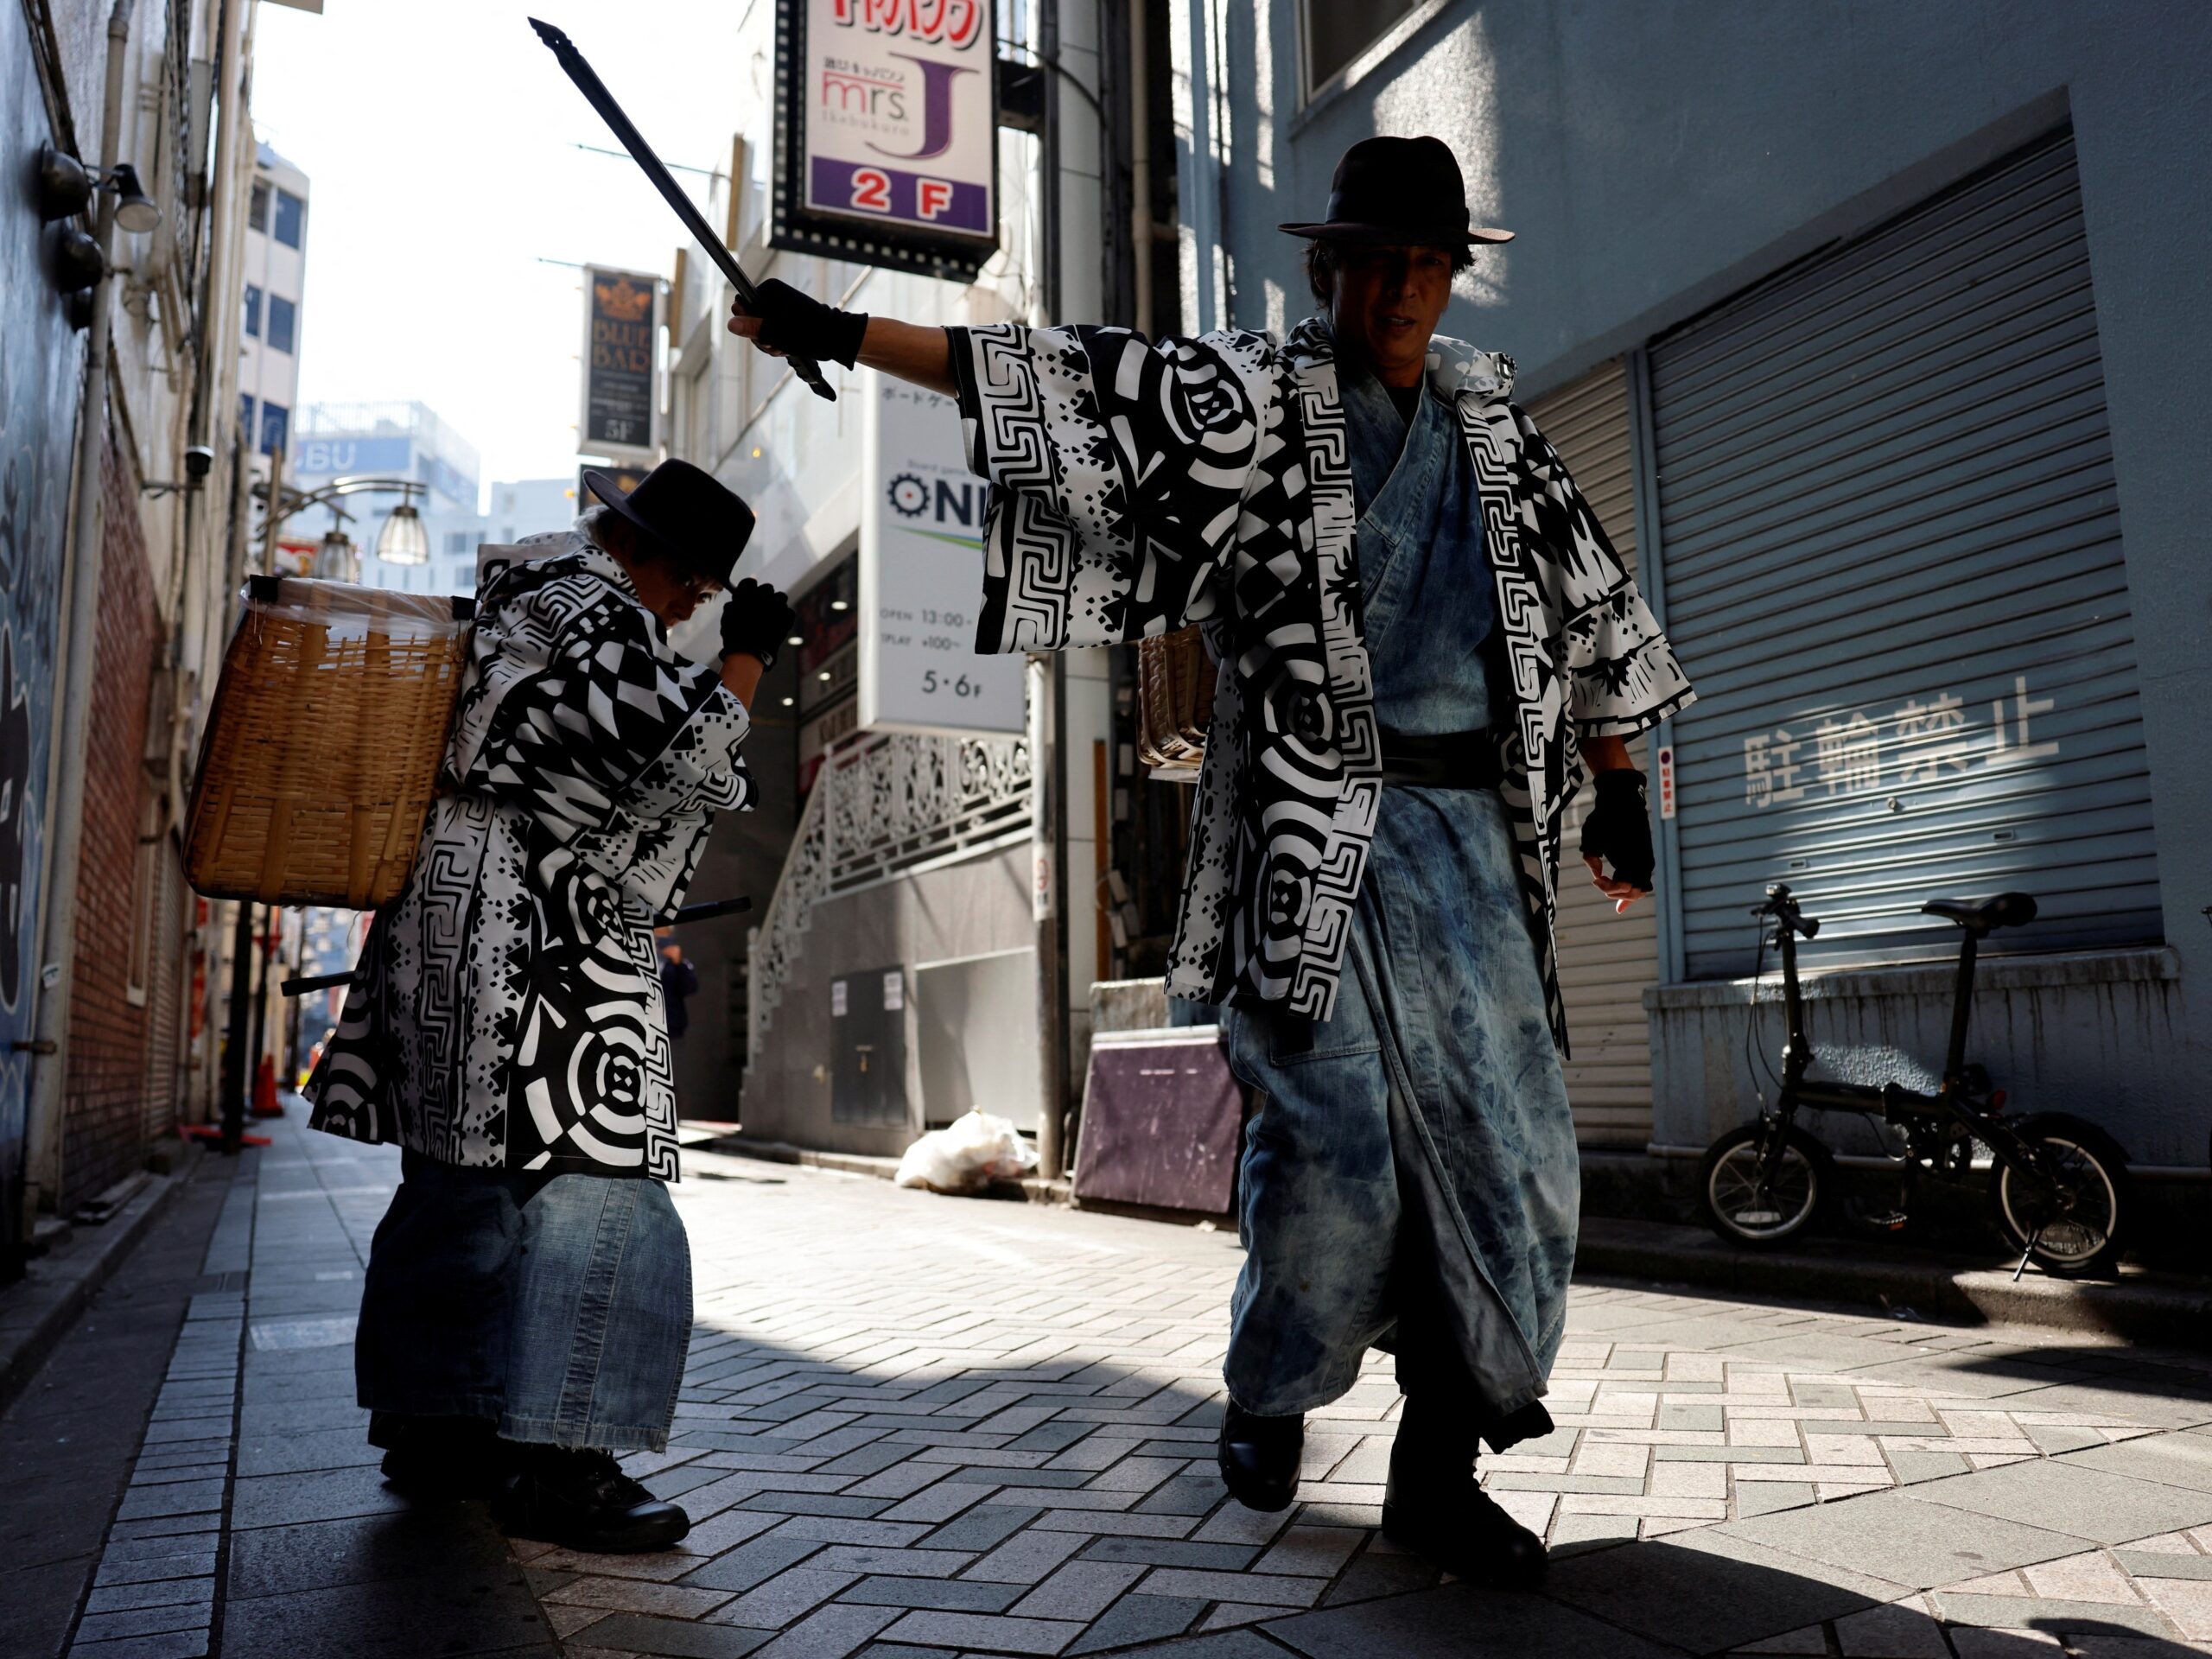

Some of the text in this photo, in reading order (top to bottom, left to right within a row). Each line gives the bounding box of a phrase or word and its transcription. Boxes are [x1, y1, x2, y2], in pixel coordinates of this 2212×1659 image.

[864, 51, 980, 160] J
[852, 169, 951, 218] 2 F
[880, 607, 912, 621] OPEN
[1744, 677, 2059, 808] 駐輪禁止
